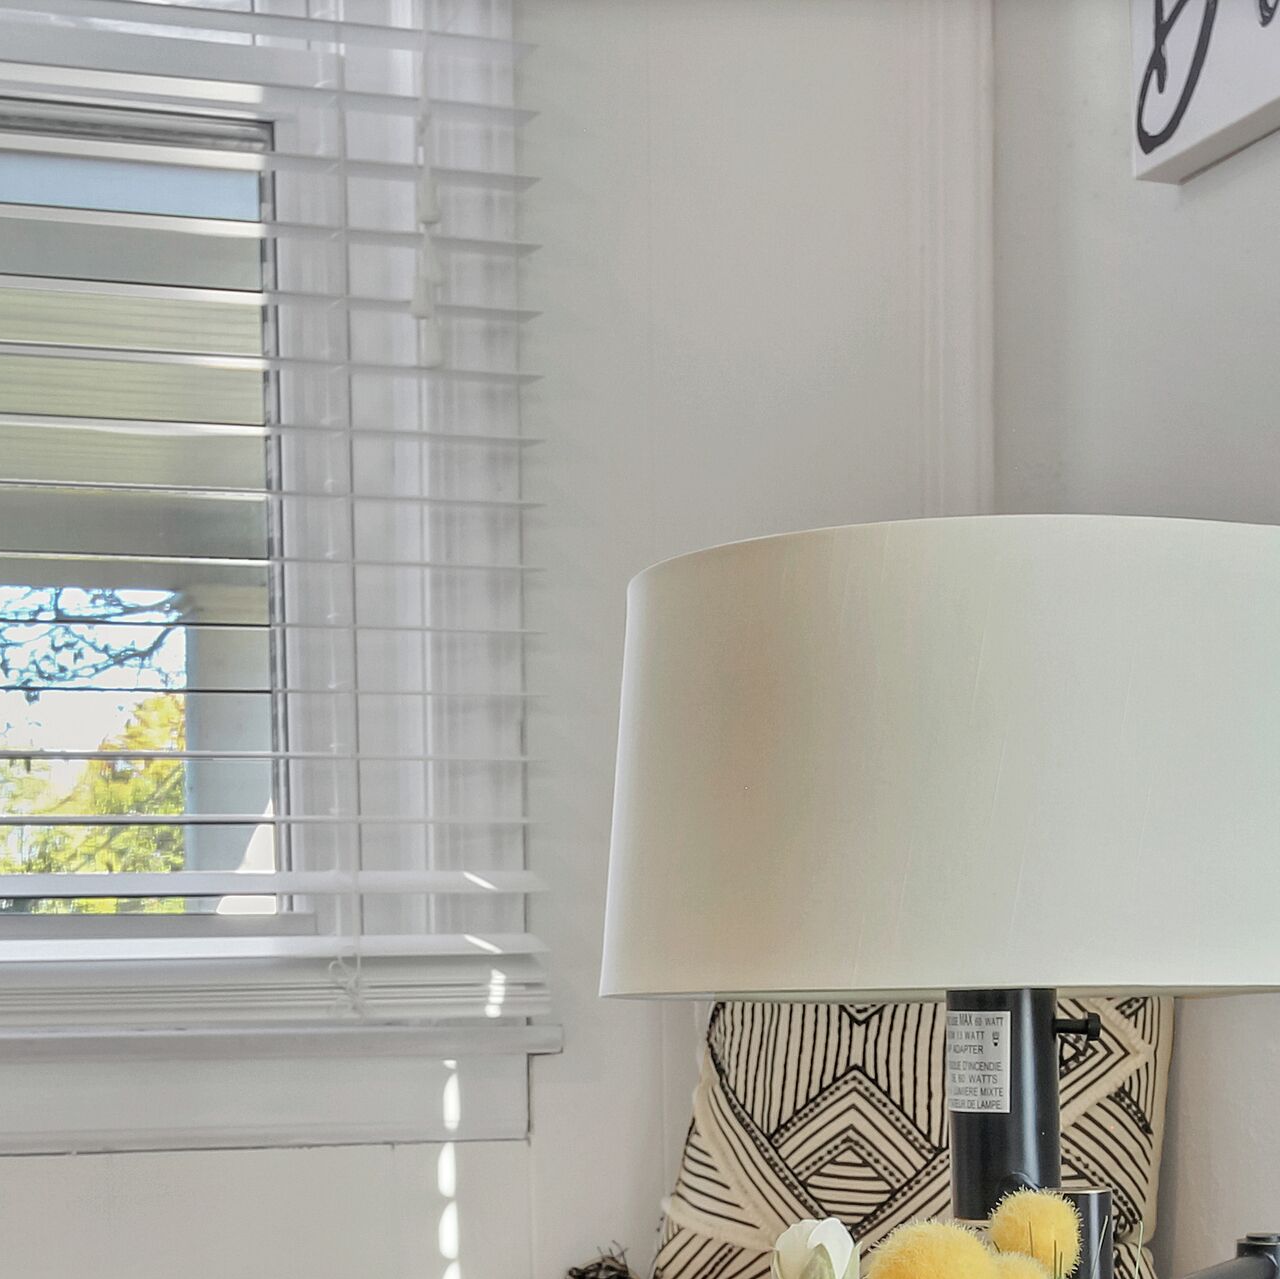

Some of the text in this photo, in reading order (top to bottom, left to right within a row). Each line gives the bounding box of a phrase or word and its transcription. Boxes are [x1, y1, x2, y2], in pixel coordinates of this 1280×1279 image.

[959, 1014, 972, 1026] MAX
[985, 1017, 1004, 1026] WATT
[965, 1031, 984, 1040] WATT
[953, 1045, 984, 1055] ADAPTER
[968, 1075, 998, 1084] WATTS
[980, 1087, 1003, 1097] MIXTE
